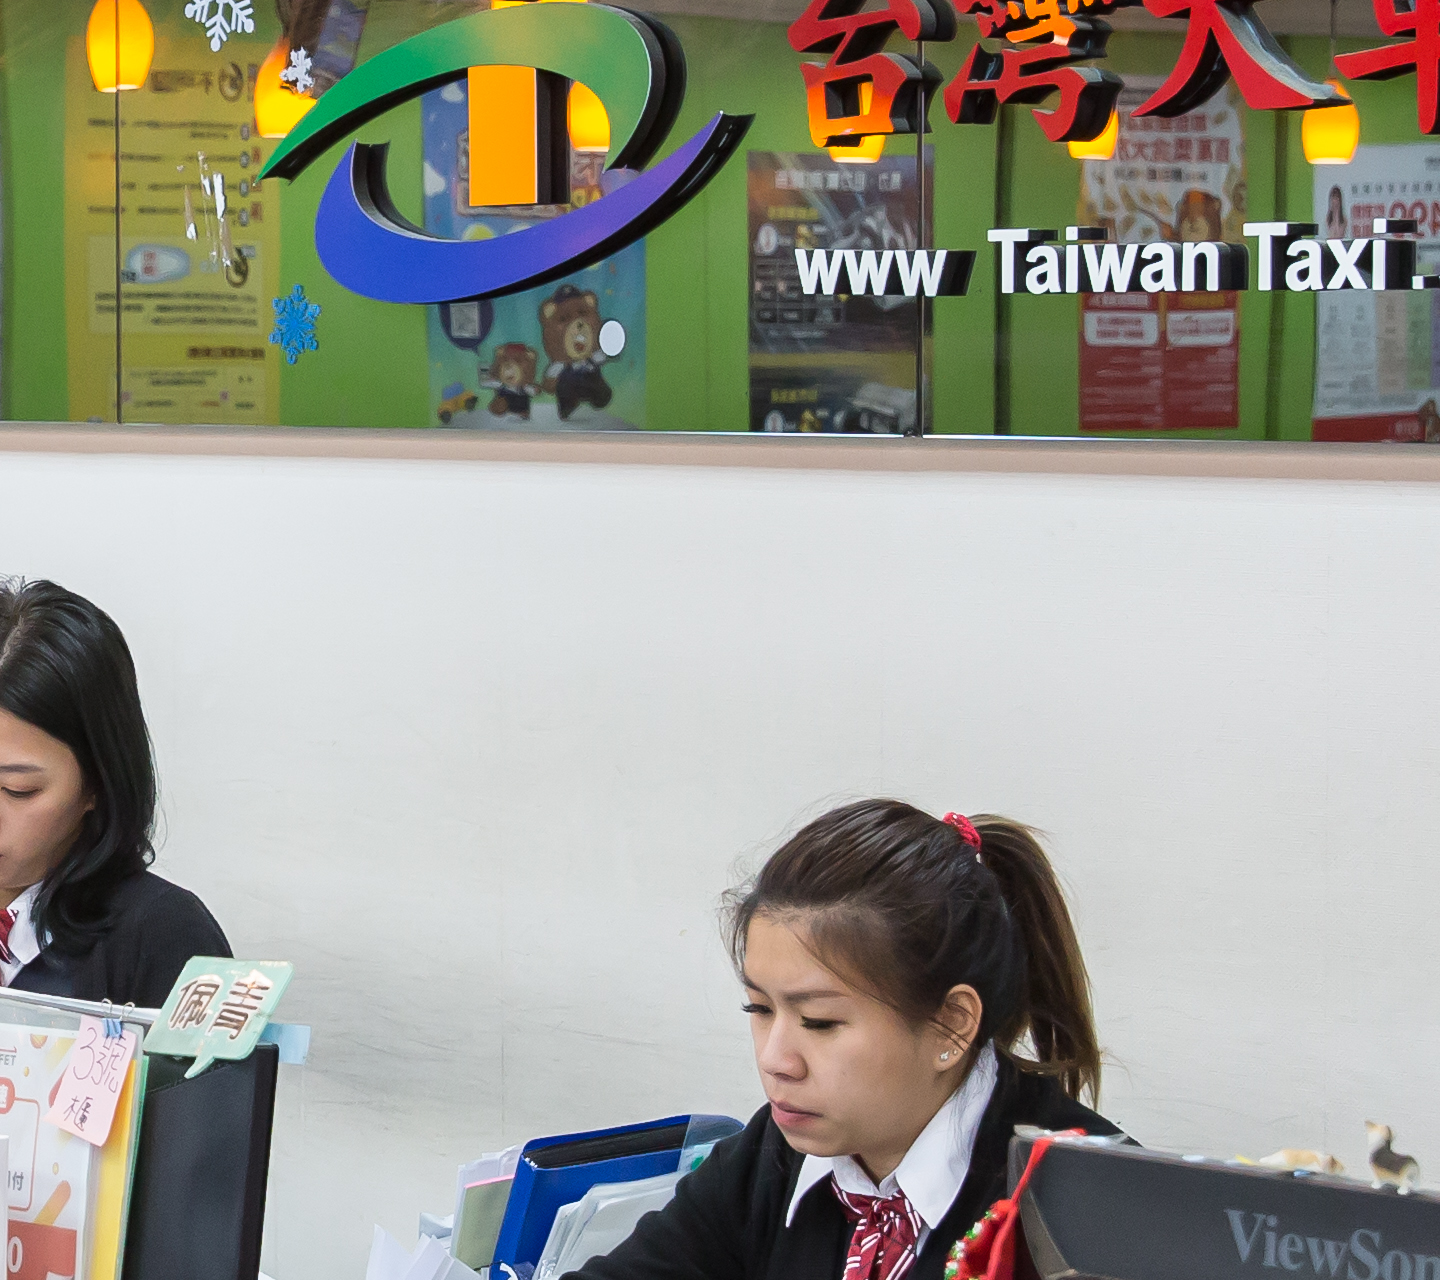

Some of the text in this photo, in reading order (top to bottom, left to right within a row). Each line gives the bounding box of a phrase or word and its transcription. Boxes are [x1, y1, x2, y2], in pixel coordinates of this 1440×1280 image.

[795, 248, 947, 296] www
[987, 227, 1219, 294] Taiwan
[169, 979, 271, 1040] 佩青
